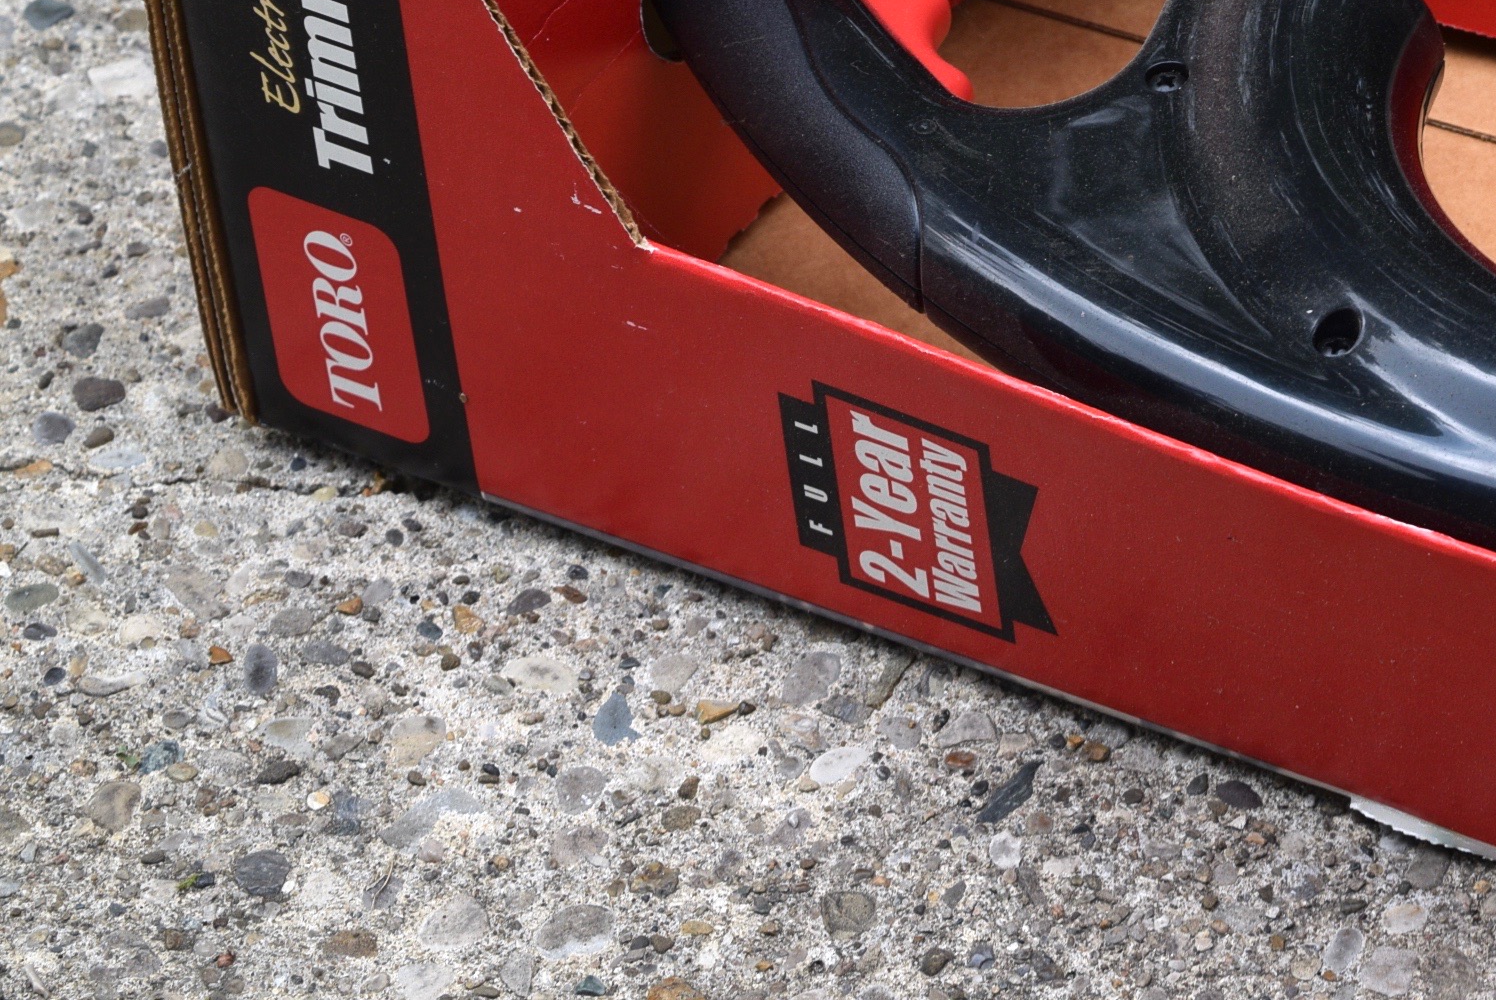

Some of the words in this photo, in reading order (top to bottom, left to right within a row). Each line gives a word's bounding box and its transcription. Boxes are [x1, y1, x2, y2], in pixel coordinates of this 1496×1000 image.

[795, 420, 834, 536] FULL
[850, 410, 930, 599] 2-Year
[920, 437, 982, 613] Warranty
